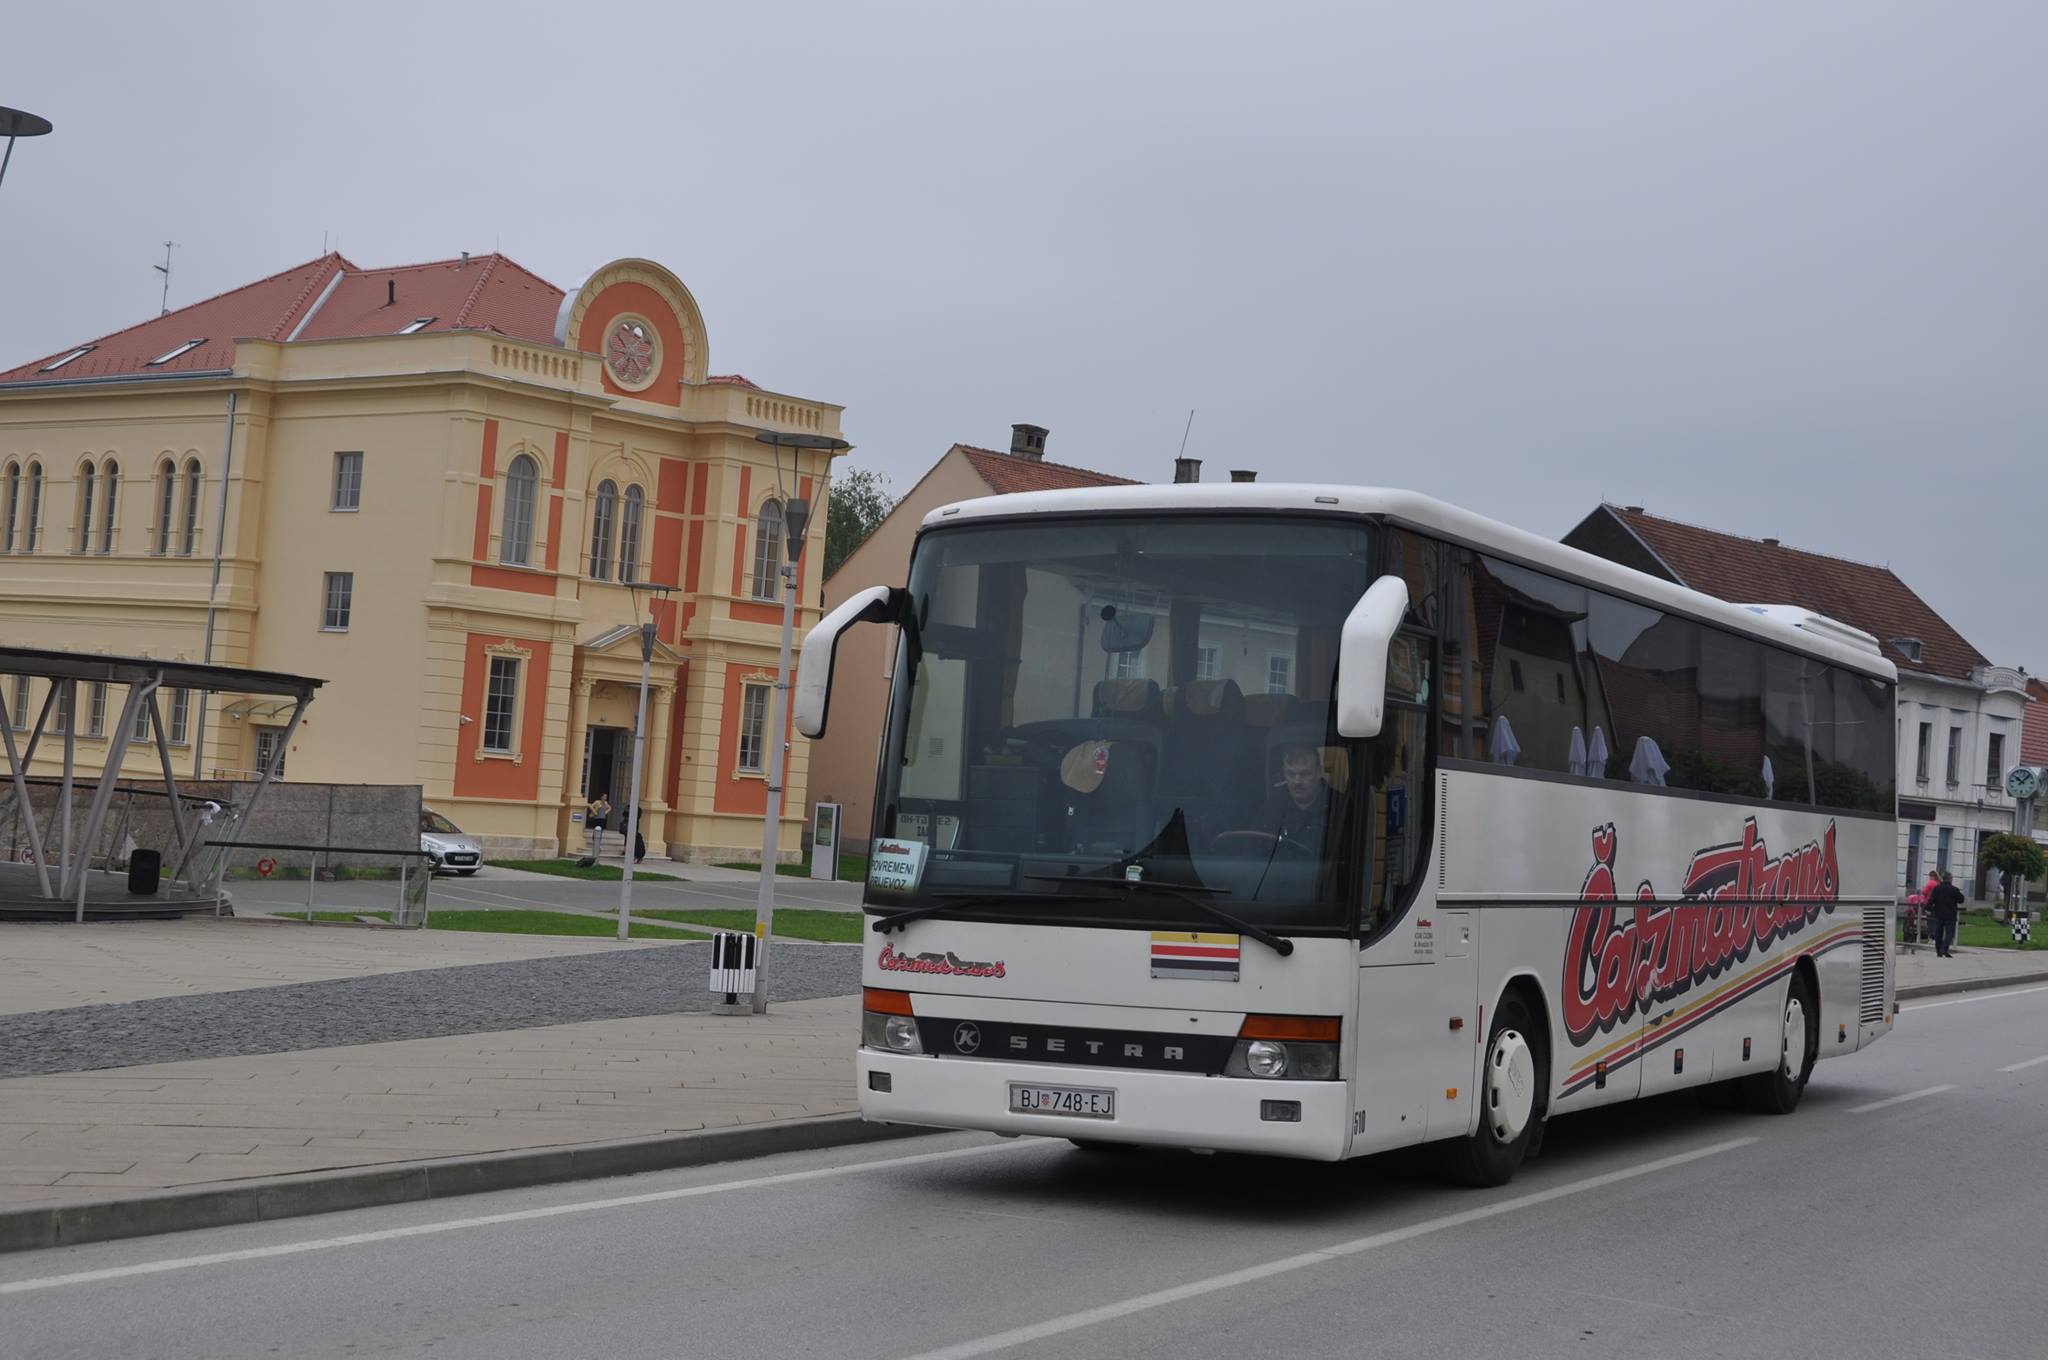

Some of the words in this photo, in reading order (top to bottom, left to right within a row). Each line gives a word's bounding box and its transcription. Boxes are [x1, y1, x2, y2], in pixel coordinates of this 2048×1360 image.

[871, 860, 915, 876] POVREMENI
[1563, 816, 1838, 1047] Čazmatrans
[1010, 1035, 1184, 1060] SETRA
[1021, 1089, 1040, 1109] BJ
[1052, 1091, 1111, 1114] 748-EJ
[1353, 1109, 1366, 1136] 510
